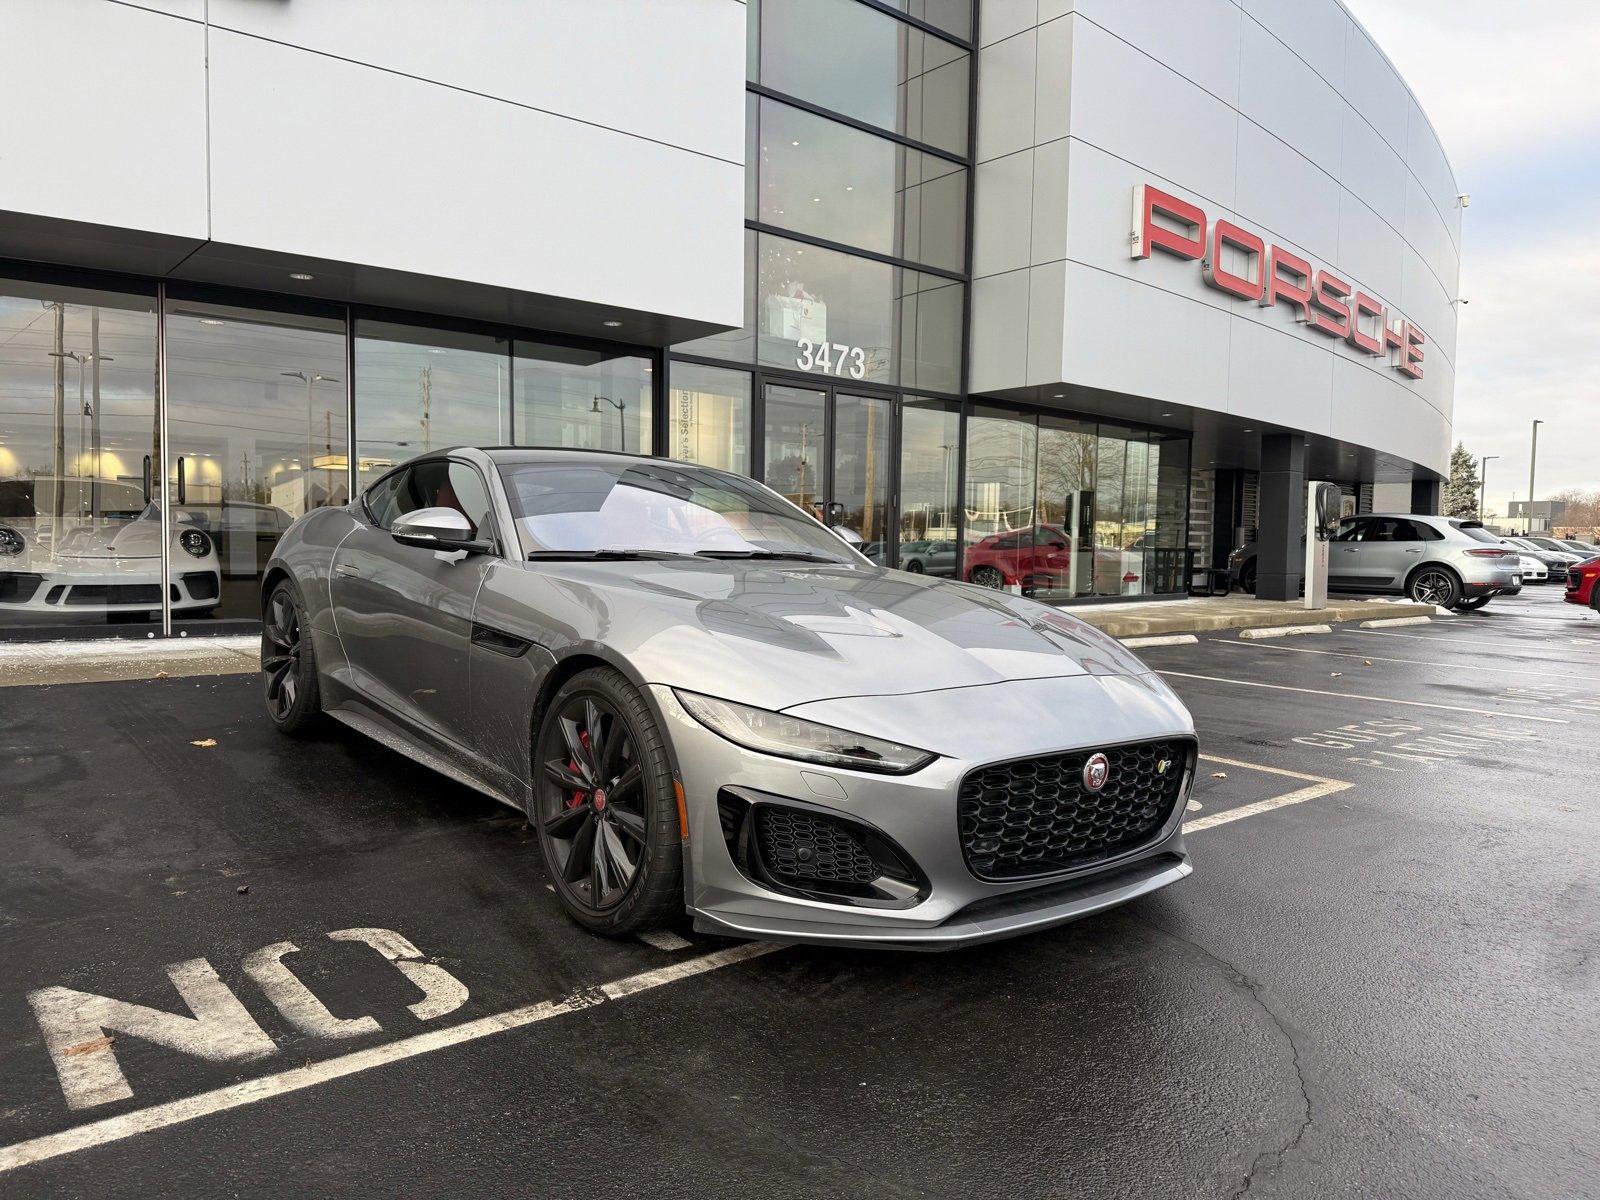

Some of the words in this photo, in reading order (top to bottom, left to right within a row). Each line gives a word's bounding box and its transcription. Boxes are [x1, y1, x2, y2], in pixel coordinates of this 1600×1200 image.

[796, 337, 865, 379] 3473
[1131, 184, 1424, 379] PORSCHE
[25, 927, 470, 1110] NO
